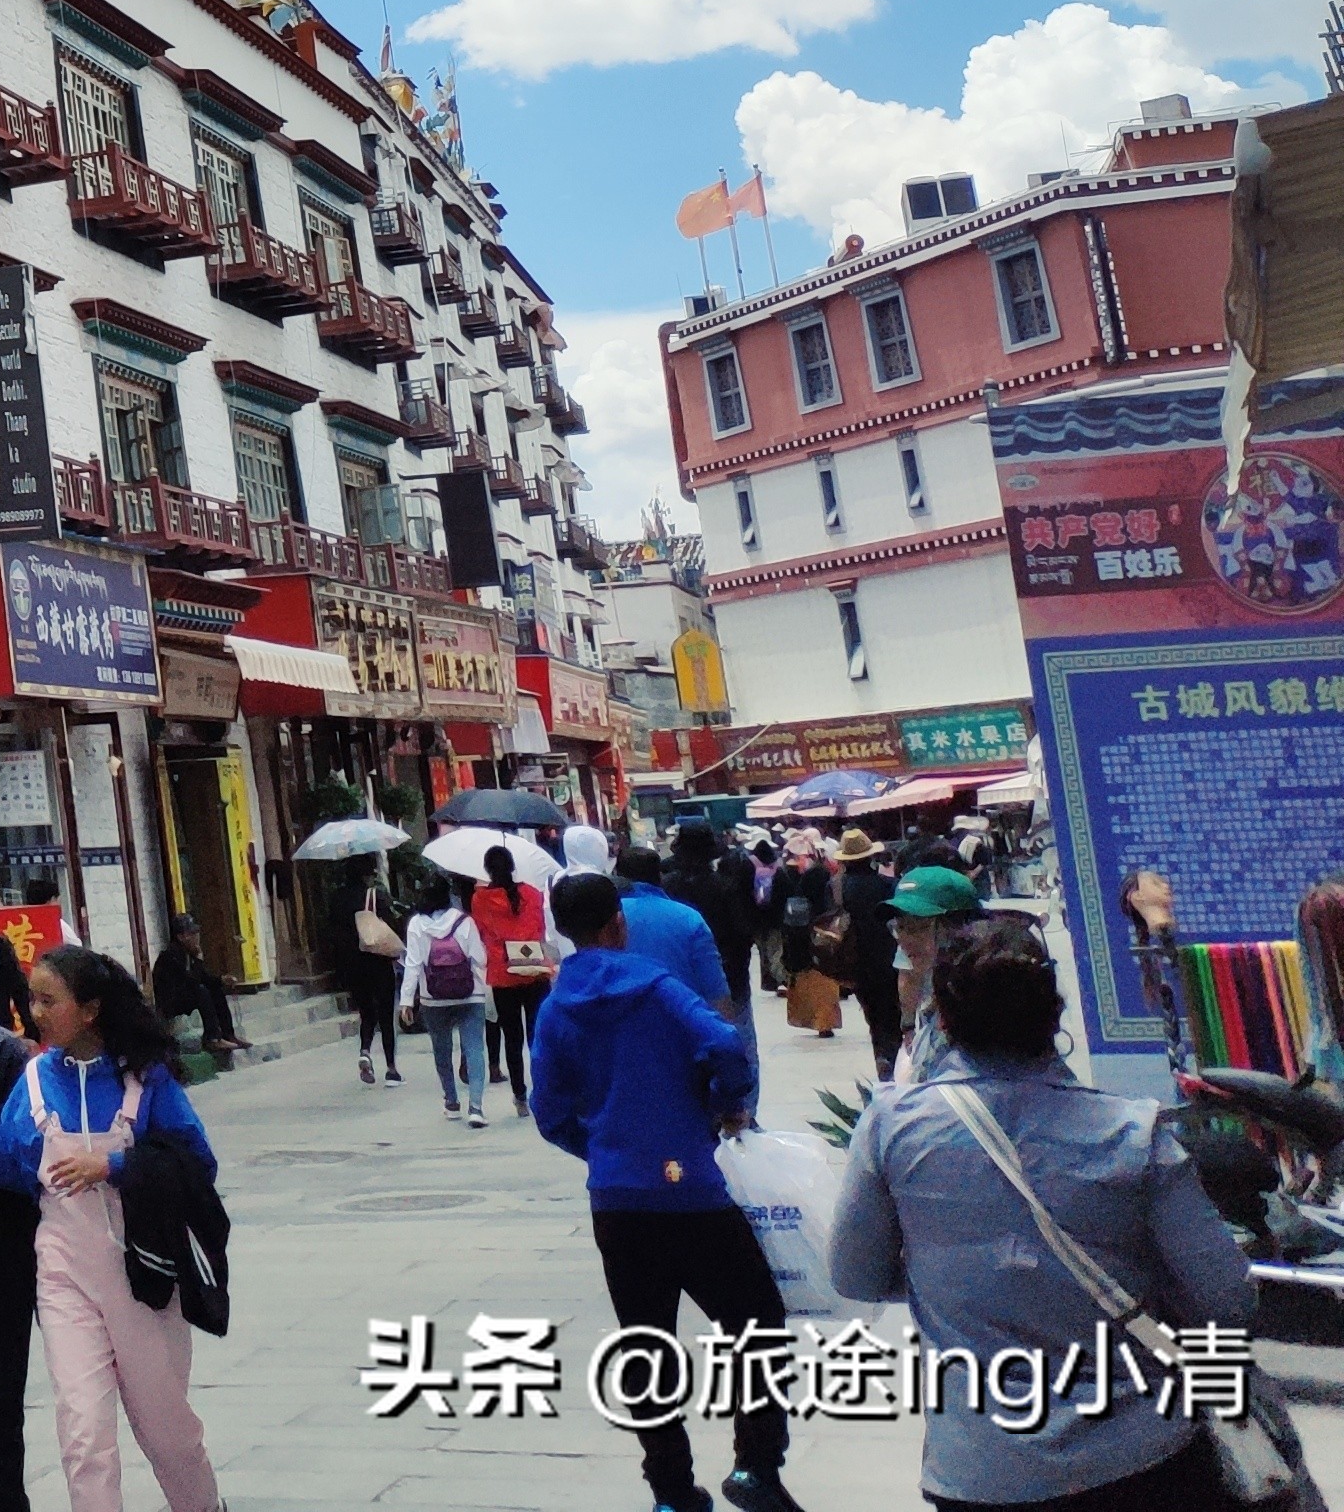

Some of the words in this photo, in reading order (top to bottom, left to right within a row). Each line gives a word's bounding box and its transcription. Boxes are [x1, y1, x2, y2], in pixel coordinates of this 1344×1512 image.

[12, 473, 37, 494] studio
[1021, 508, 1161, 552] 共产党好
[1093, 546, 1184, 581] 百姓乐
